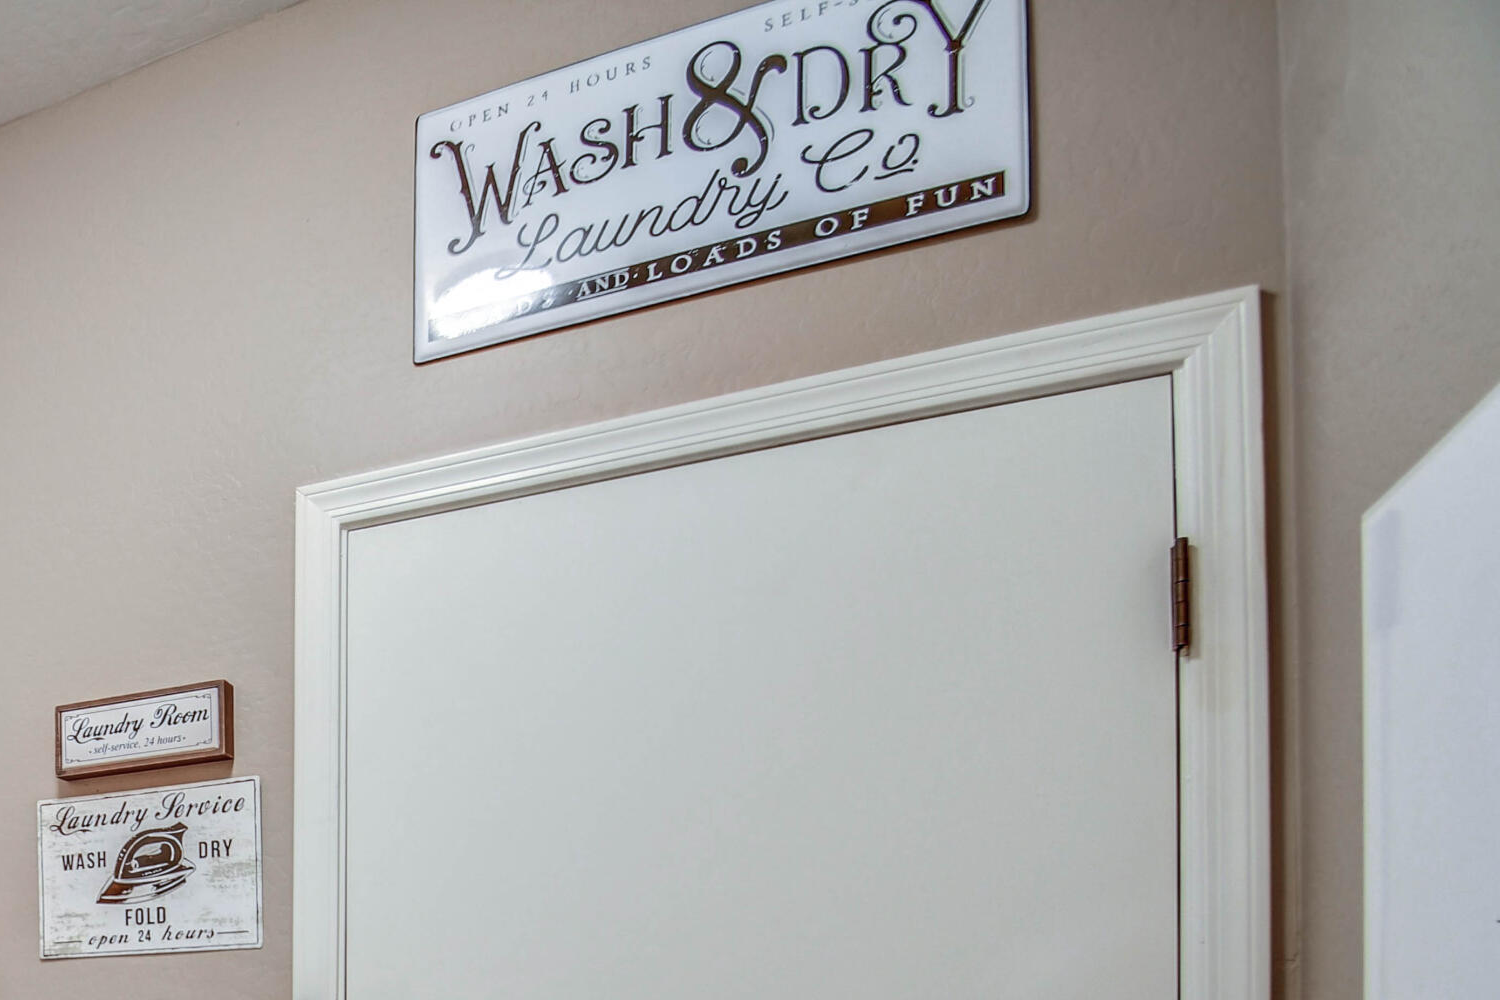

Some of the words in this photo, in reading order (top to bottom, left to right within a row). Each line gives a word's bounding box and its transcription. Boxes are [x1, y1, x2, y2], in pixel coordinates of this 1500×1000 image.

[449, 103, 510, 132] OPEN
[526, 90, 549, 107] 24
[569, 56, 652, 94] HOURS
[429, 94, 674, 255] WASH
[682, 40, 788, 178] &
[791, 0, 990, 126] DRY
[494, 168, 789, 280] Laundry
[575, 269, 631, 300] AND
[646, 229, 783, 283] LOADS
[813, 207, 870, 239] OF
[905, 177, 999, 217] FUN
[66, 712, 144, 744] Laundry
[149, 703, 210, 730] Room
[143, 736, 155, 748] 24
[156, 733, 183, 746] hours
[50, 801, 149, 836] Laundry
[154, 791, 245, 820] Service
[61, 851, 107, 872] WASH
[198, 838, 233, 859] DRY
[125, 906, 167, 926] FOLD
[88, 930, 130, 950] open
[137, 929, 151, 943] 24
[162, 925, 215, 942] hours
